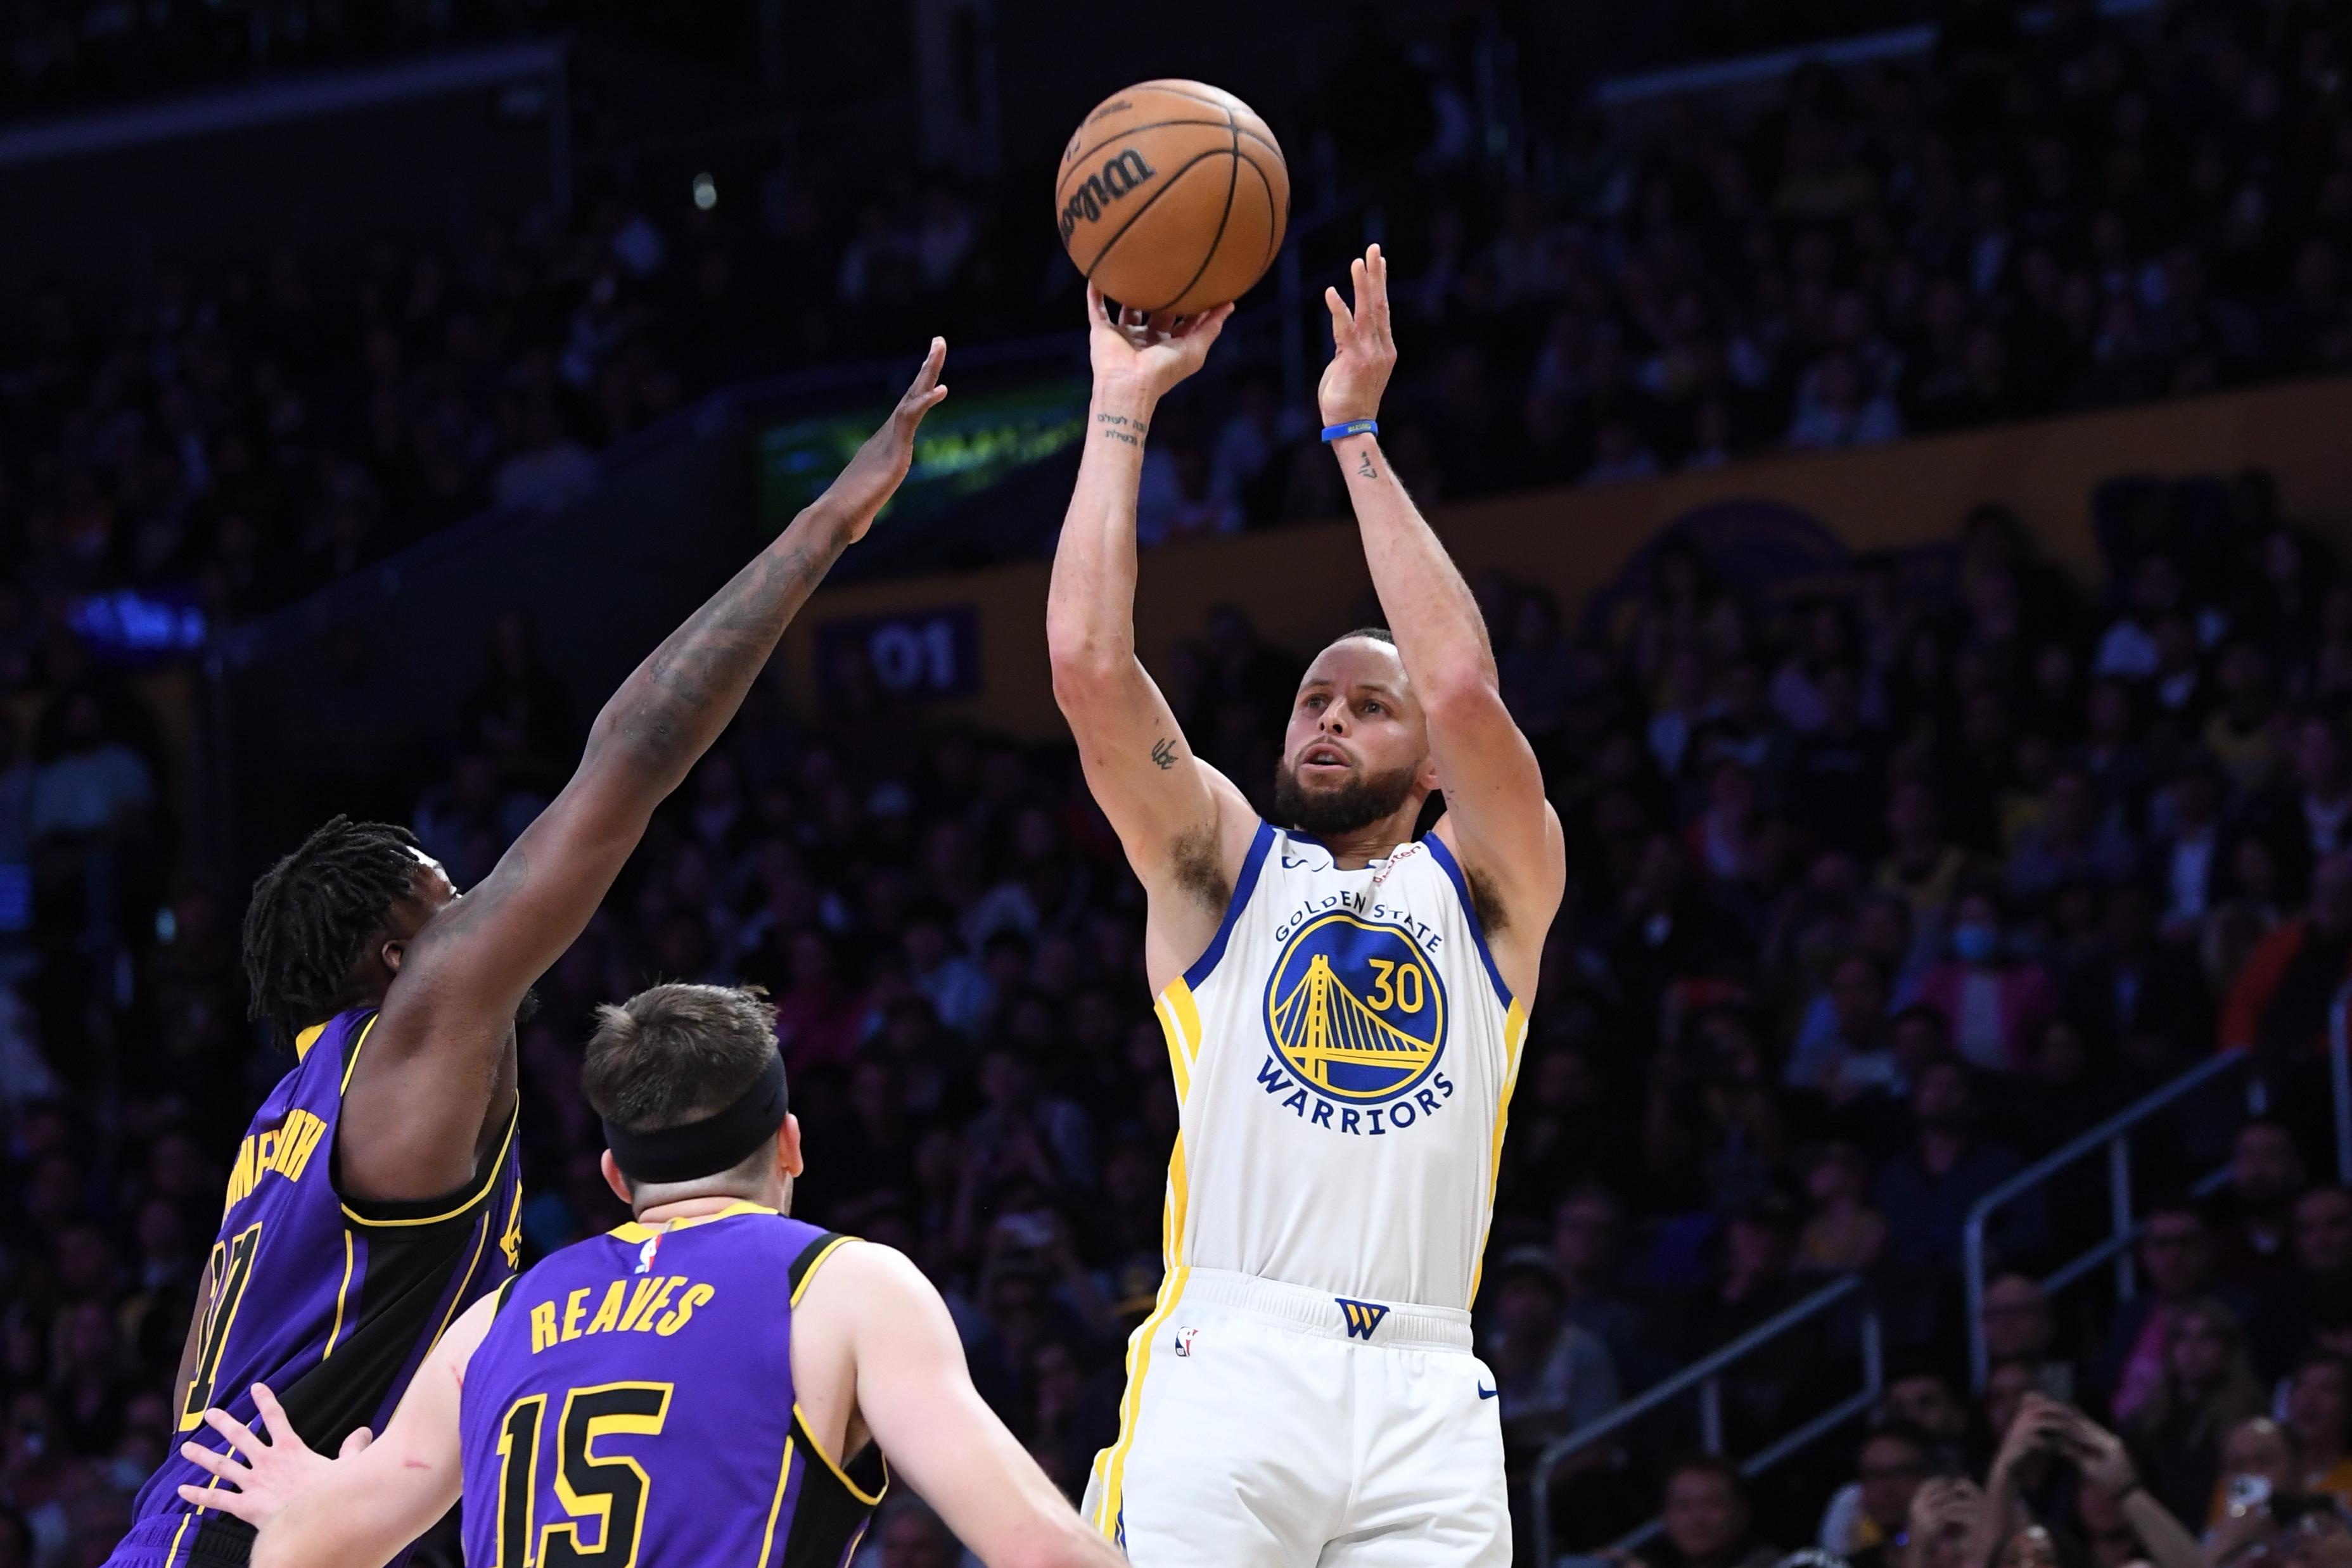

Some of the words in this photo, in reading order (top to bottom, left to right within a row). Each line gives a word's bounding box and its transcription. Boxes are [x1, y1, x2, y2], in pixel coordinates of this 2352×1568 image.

[1060, 148, 1156, 247] Wilso
[868, 619, 955, 691] 01
[1275, 890, 1367, 943] GOLDEN
[1373, 904, 1443, 953] STATE
[1366, 958, 1424, 1014] 30
[1256, 1054, 1454, 1136] WARRIORS
[530, 1275, 715, 1354] REAVES
[489, 1380, 674, 1568] 15
